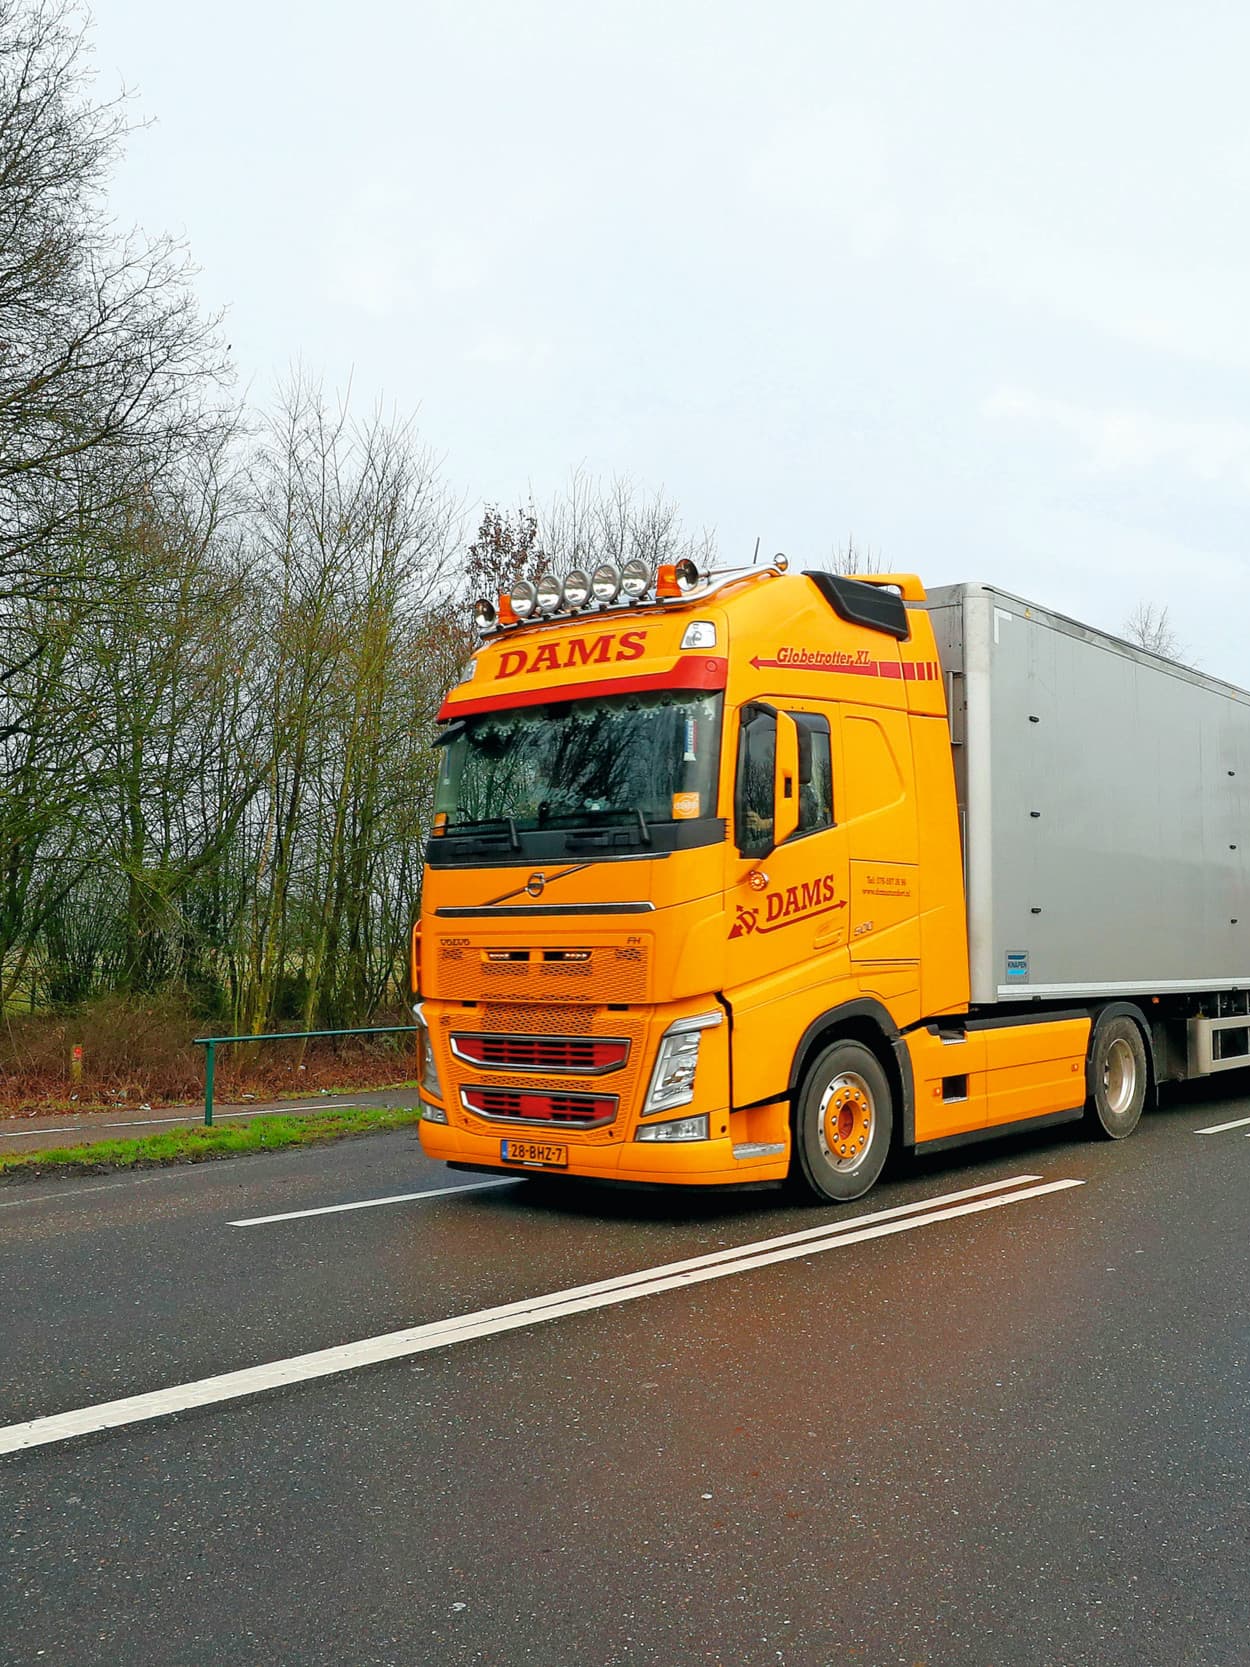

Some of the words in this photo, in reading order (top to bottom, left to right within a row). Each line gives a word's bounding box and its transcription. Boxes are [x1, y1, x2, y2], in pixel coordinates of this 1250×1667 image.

[494, 631, 647, 680] DAMS
[776, 647, 853, 665] Globetrotter
[854, 650, 871, 665] XL
[766, 874, 834, 922] DAMS
[511, 1143, 563, 1162] 28-BHZ-7
